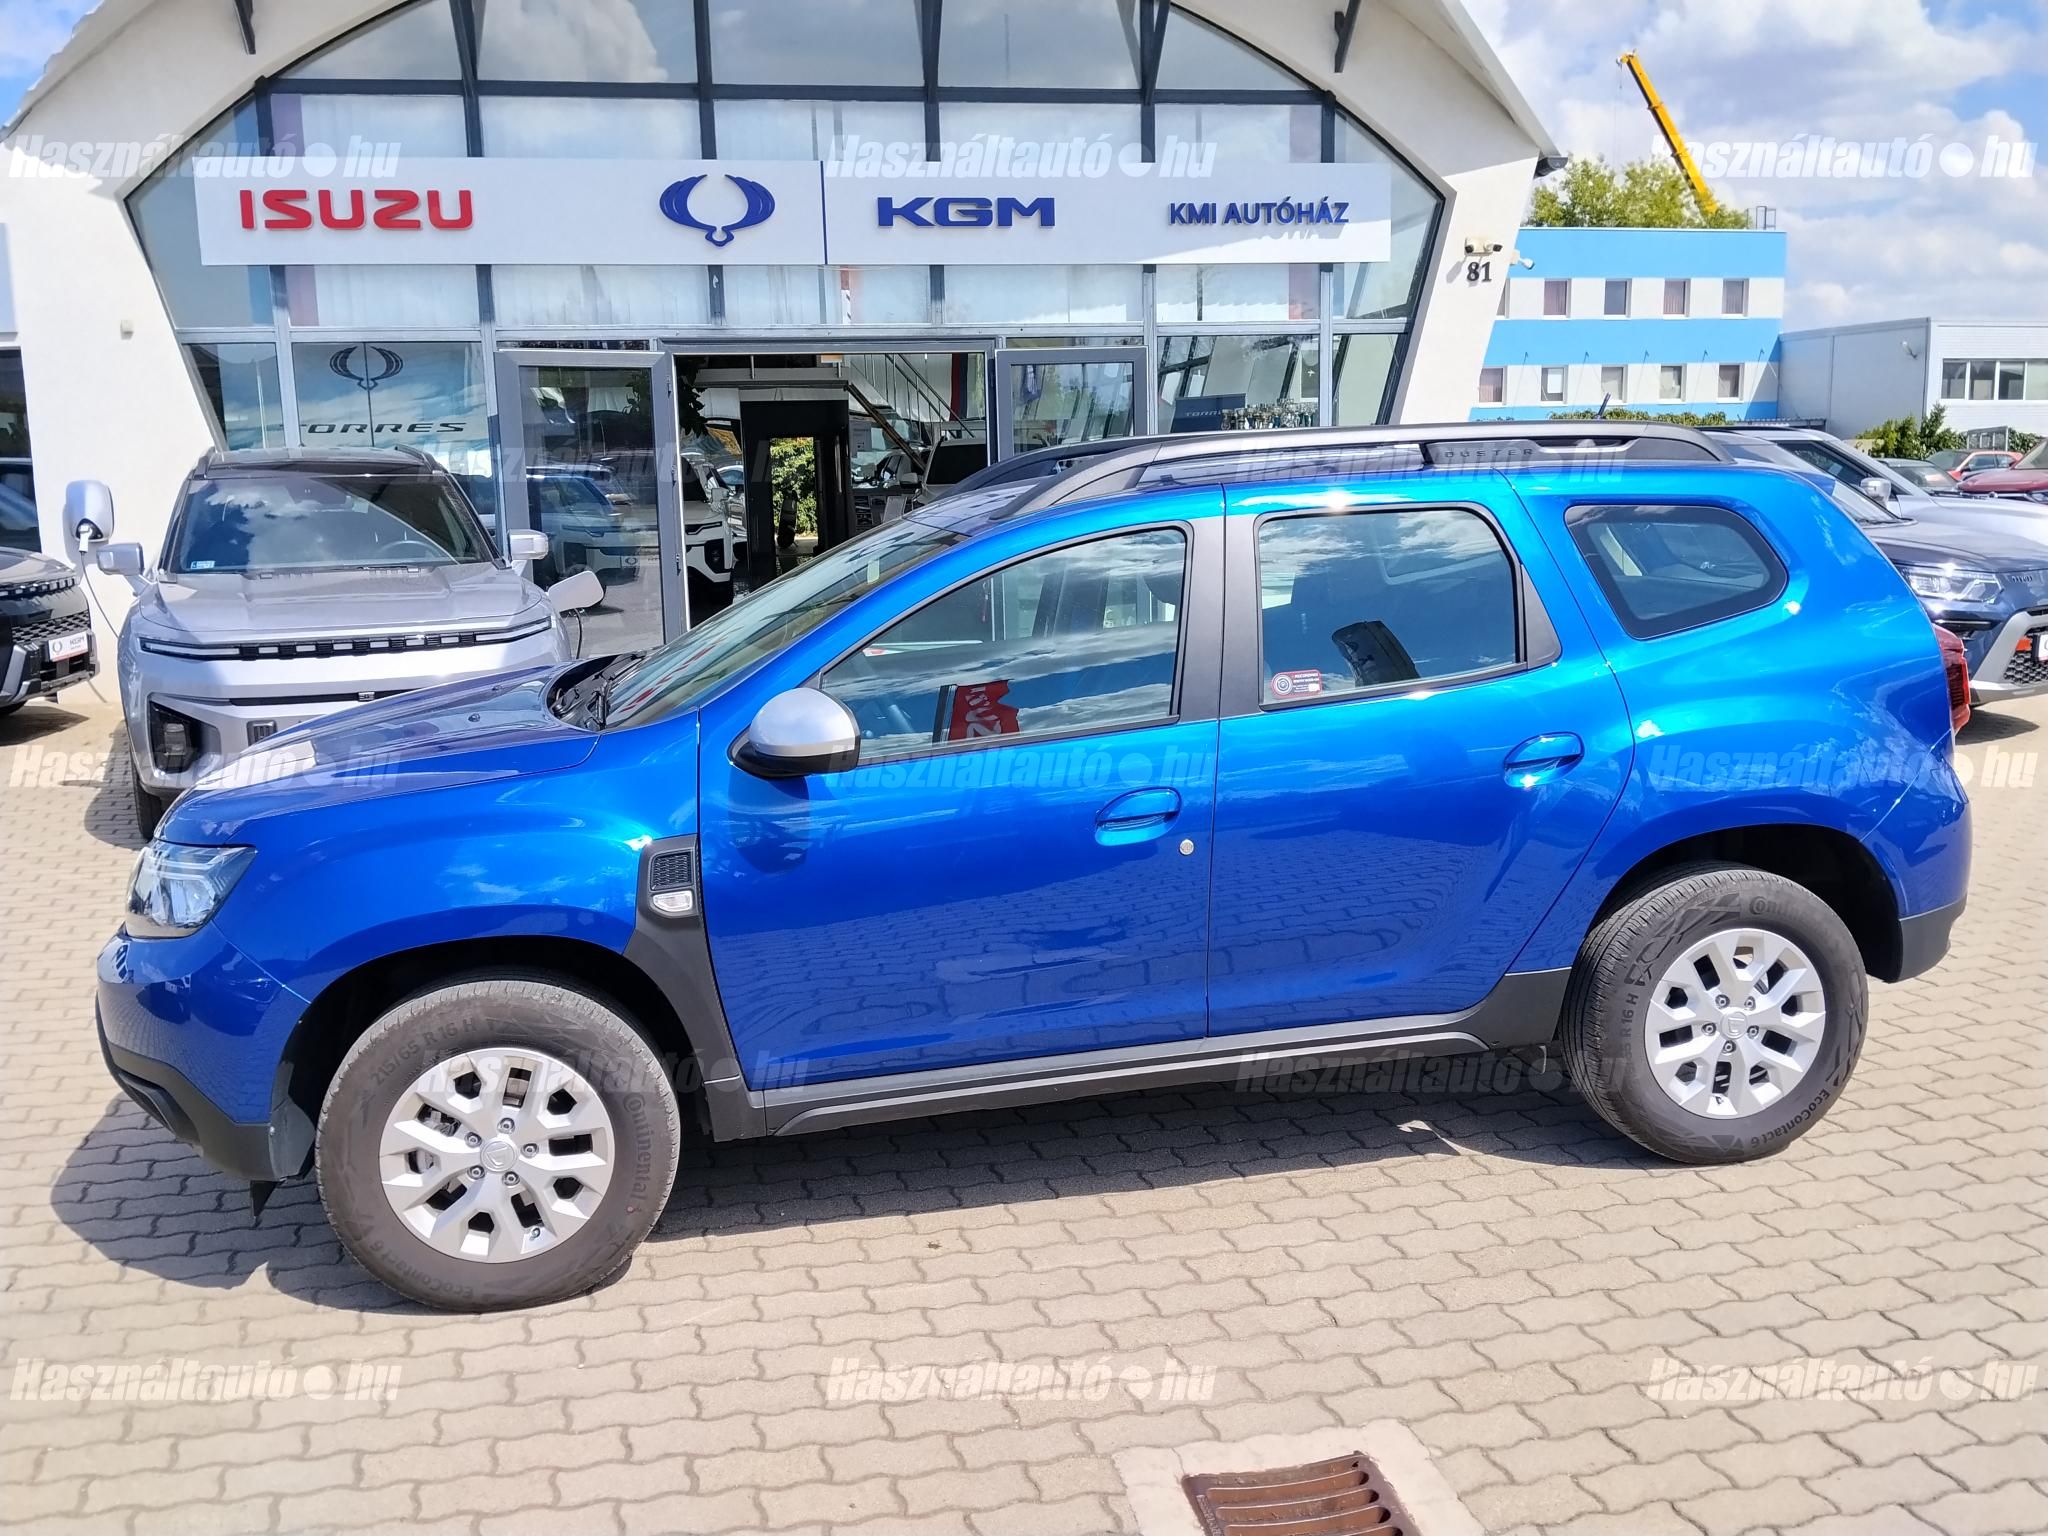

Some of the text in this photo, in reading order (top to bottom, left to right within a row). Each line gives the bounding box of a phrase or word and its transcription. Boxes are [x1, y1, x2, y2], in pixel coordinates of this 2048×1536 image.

[239, 189, 473, 230] ISUZU
[877, 197, 1056, 227] KGM
[1170, 196, 1349, 224] KMI AUTÓHÁZ
[1466, 261, 1492, 283] 81
[299, 422, 467, 434] ORRES
[1444, 448, 1533, 458] DUSTER
[622, 1092, 653, 1202] Continental
